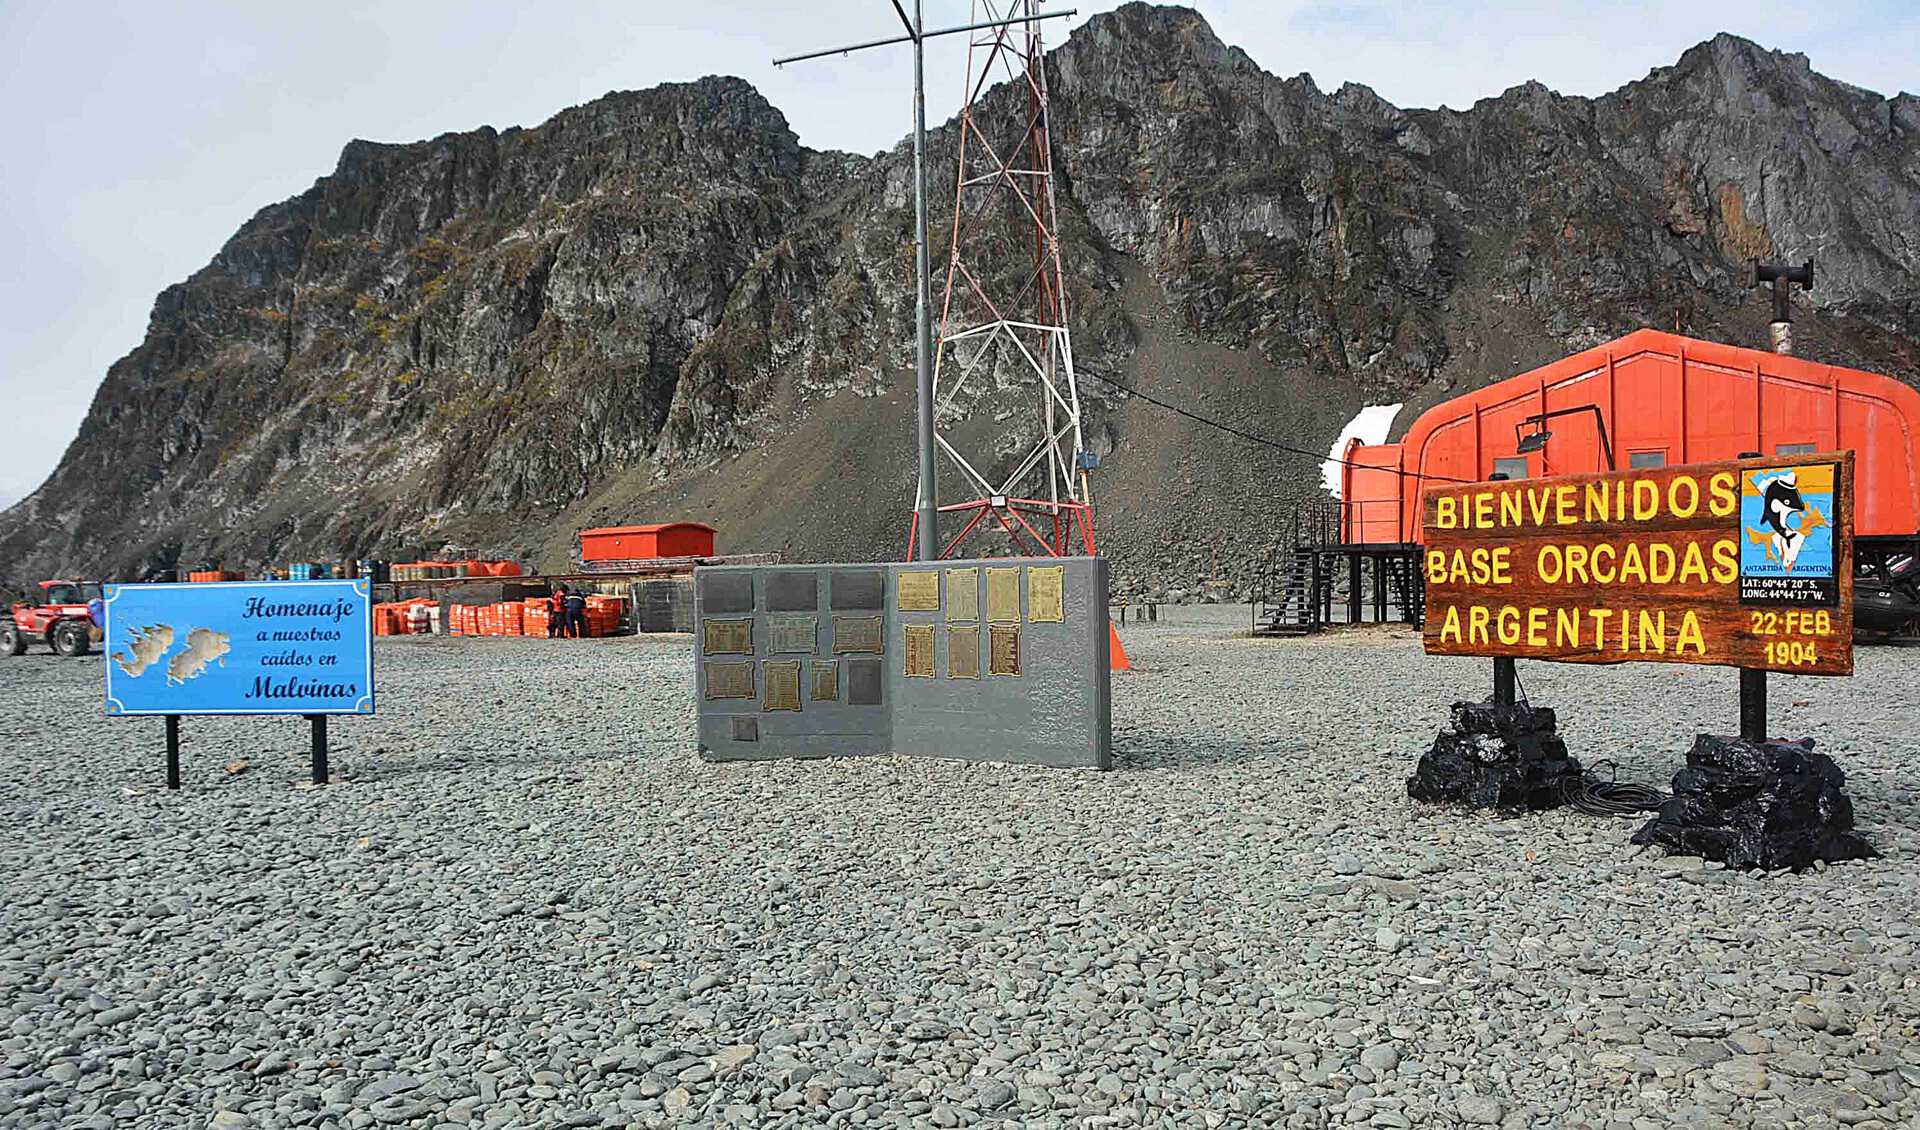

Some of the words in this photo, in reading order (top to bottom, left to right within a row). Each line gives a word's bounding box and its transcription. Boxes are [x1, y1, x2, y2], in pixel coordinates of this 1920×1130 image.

[1436, 472, 1736, 529] BIENVENIDOS
[1427, 546, 1513, 584] BASE
[1537, 539, 1739, 584] ORCADAS
[1792, 564, 1832, 572] ARGENTINA
[1742, 578, 1761, 588] LAT:
[1742, 589, 1768, 598] LONG:
[242, 597, 354, 623] Homenaje
[256, 631, 268, 641] a
[272, 627, 341, 641] nuestros
[1440, 605, 1706, 656] ARGENTINA
[261, 649, 312, 666] caídos
[318, 654, 339, 666] en
[1764, 641, 1817, 665] 1904
[245, 676, 356, 698] Malvinas
